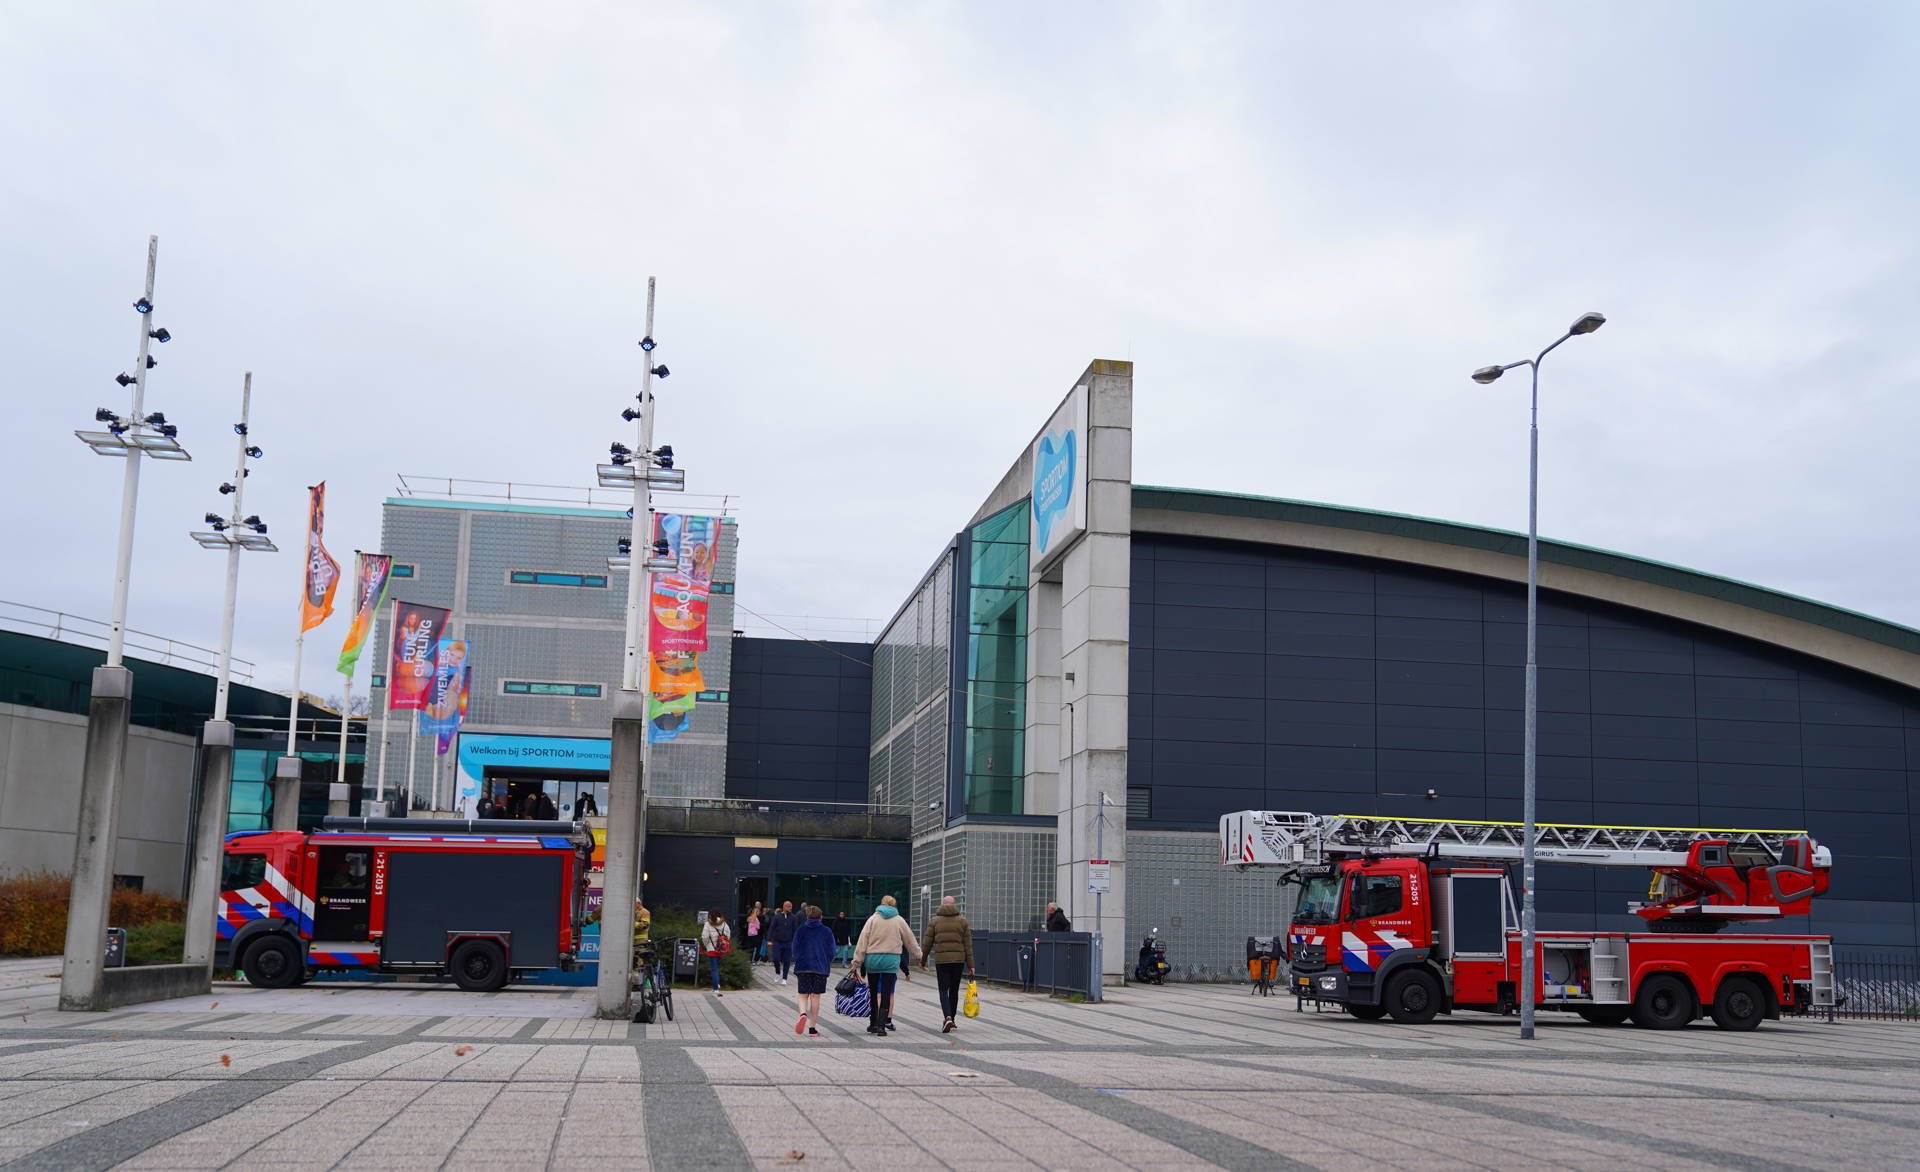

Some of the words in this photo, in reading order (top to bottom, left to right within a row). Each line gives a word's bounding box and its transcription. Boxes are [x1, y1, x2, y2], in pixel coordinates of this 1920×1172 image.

[677, 532, 694, 614] AQUAFUN
[414, 619, 432, 677] CURLING
[437, 650, 450, 708] ZWEMLES
[470, 746, 506, 755] Welkom
[508, 746, 519, 757] bij
[522, 747, 574, 758] SPORTIOM
[374, 859, 385, 895] 21-2031
[1409, 873, 1419, 906] 21-2051
